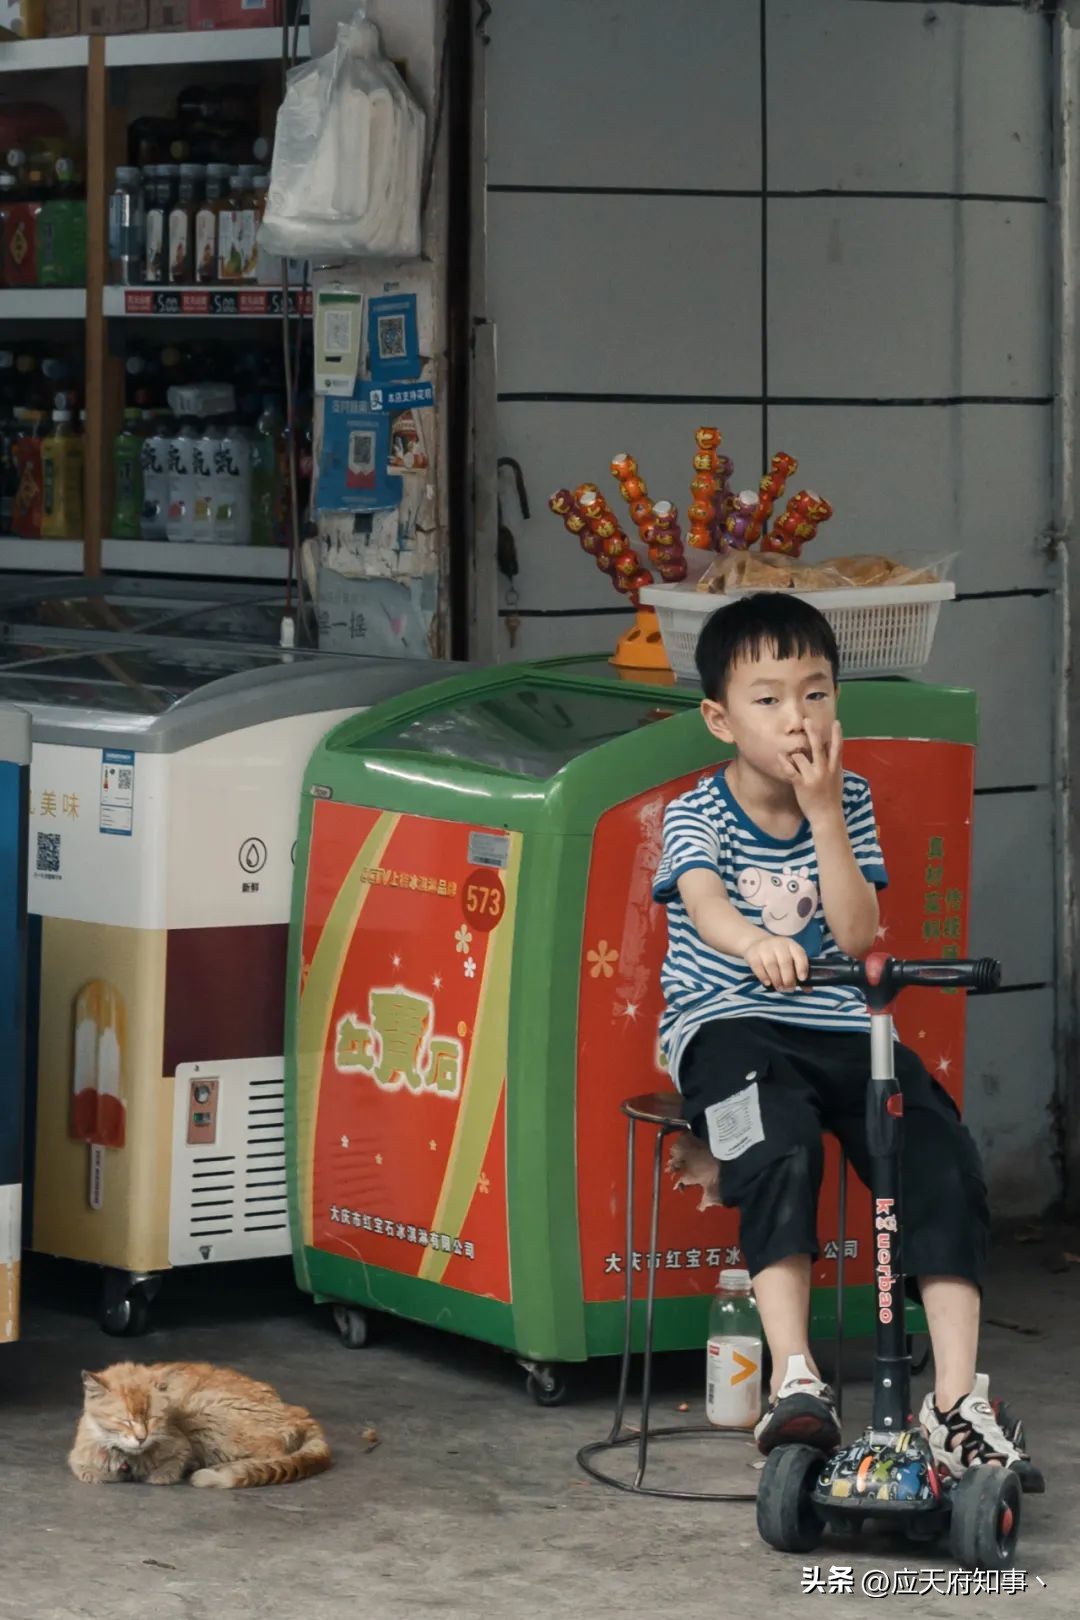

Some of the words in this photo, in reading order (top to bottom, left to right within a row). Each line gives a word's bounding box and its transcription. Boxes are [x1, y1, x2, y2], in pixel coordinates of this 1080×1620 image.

[466, 885, 501, 916] 573
[329, 1205, 475, 1259] 大庆市红宝石冰淇淋有限公司
